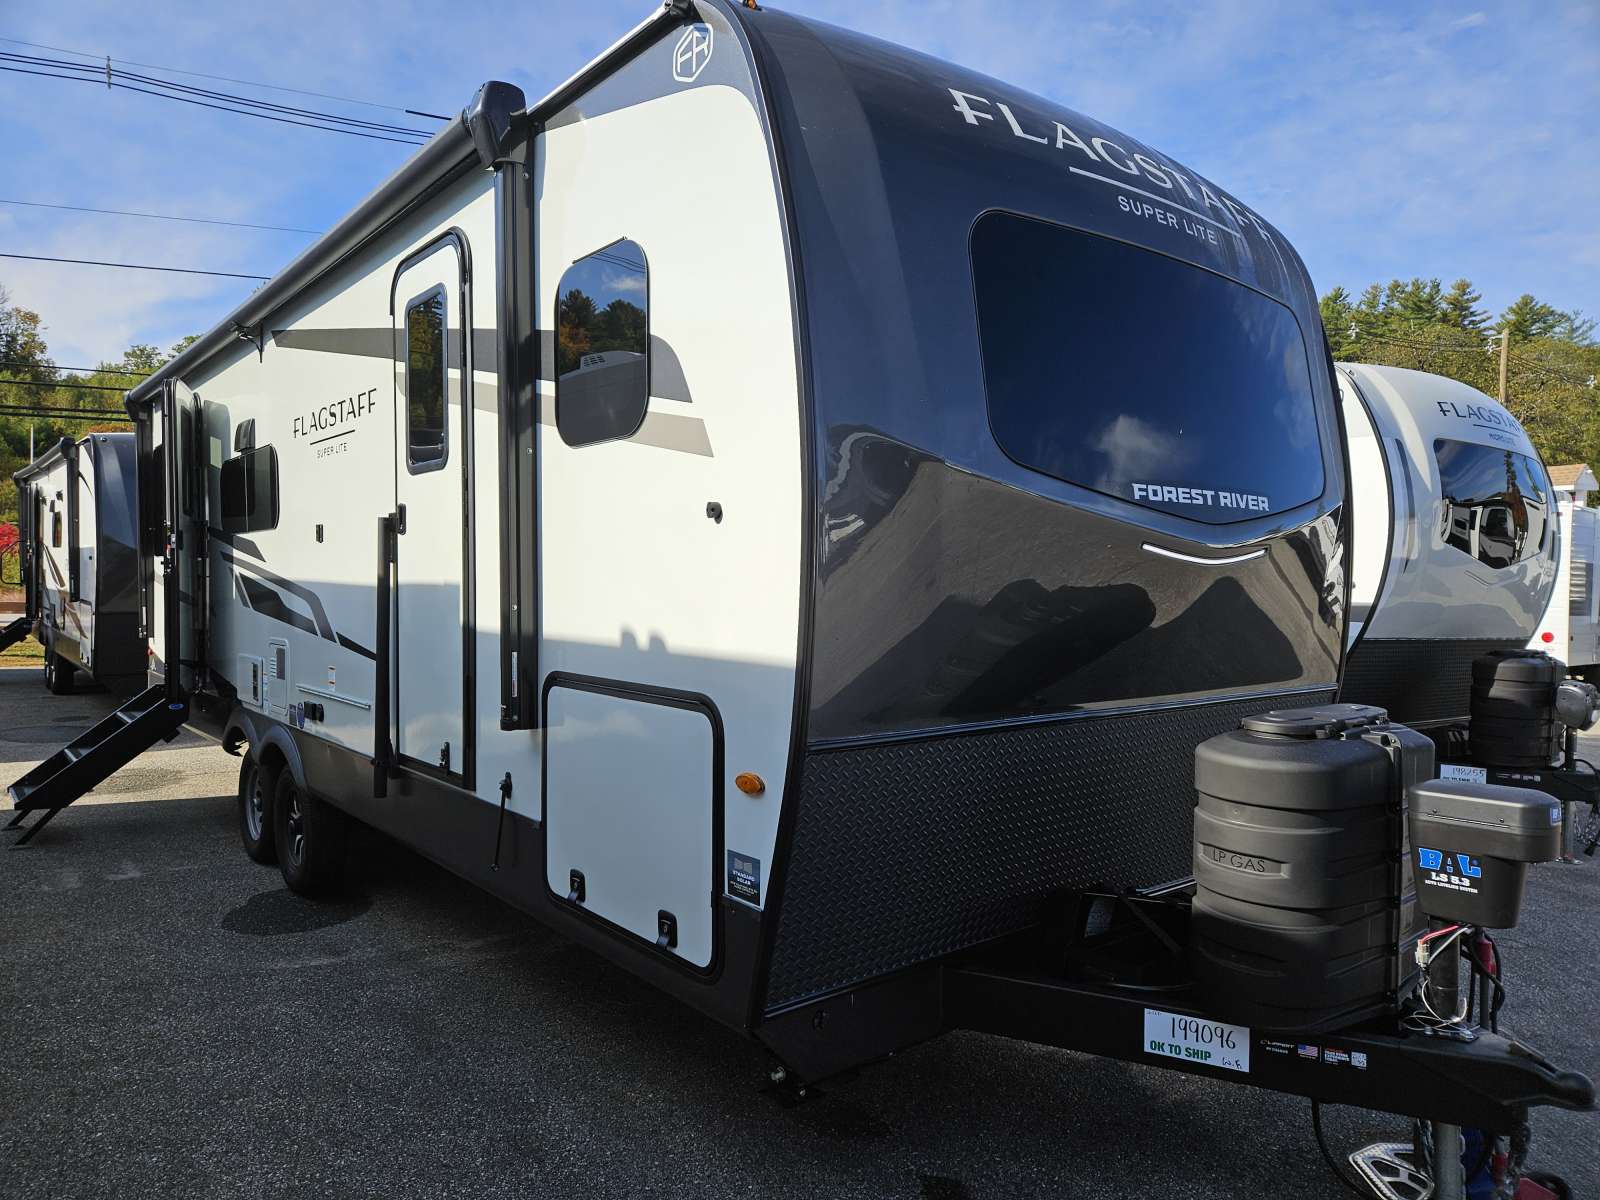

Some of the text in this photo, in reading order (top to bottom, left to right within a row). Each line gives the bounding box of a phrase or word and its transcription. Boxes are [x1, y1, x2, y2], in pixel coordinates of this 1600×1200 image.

[948, 87, 1269, 241] FLAGSTAFF
[1117, 195, 1218, 245] SUPER LITE
[293, 388, 377, 438] FLAGSTAFF
[1131, 483, 1269, 511] FOREST RIVER
[1213, 848, 1265, 872] LP GAS
[1430, 871, 1449, 882] LS
[1172, 1017, 1236, 1050] 199096
[1149, 1040, 1212, 1061] OK TO SHIP
